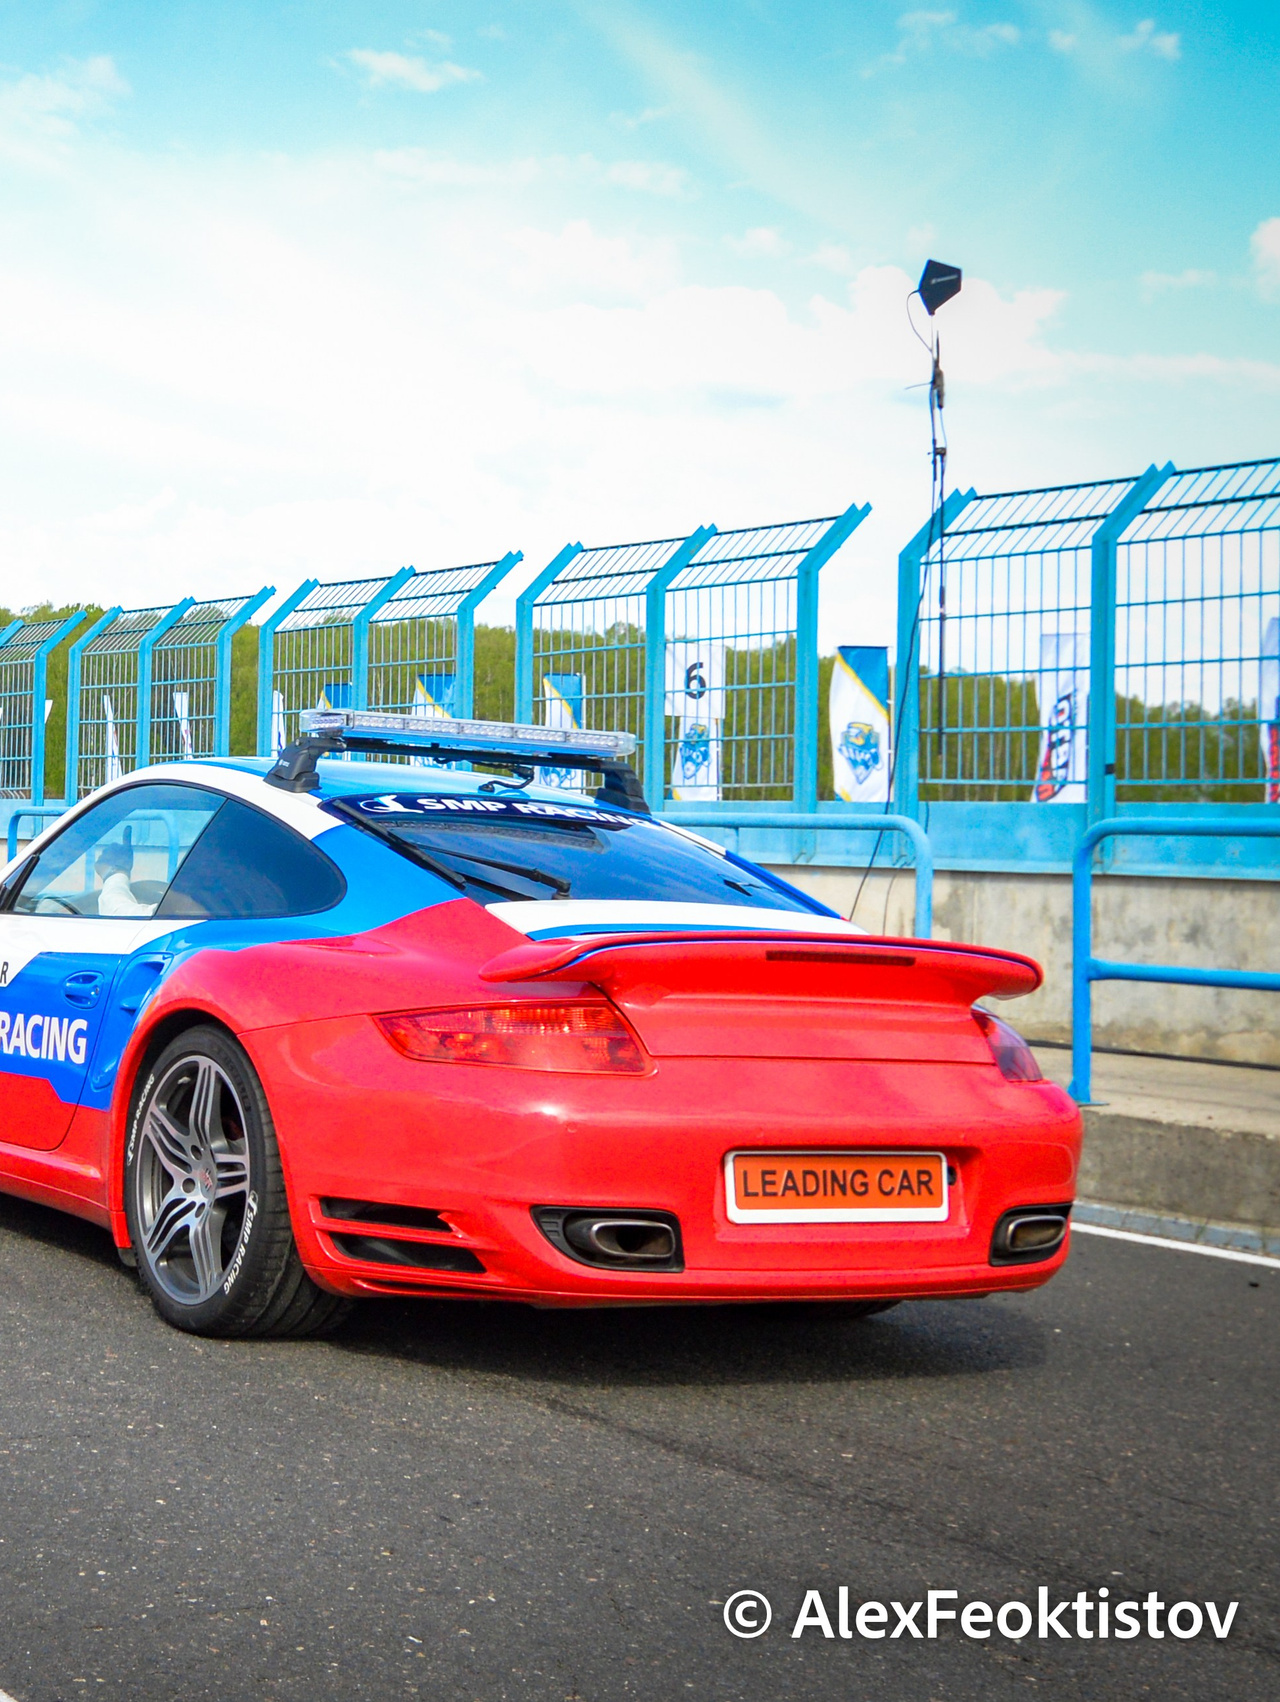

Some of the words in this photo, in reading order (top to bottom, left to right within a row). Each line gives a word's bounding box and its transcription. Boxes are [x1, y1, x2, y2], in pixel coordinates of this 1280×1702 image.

[684, 661, 706, 700] 6
[416, 798, 507, 812] SMP
[511, 802, 664, 830] RACING
[136, 1073, 155, 1120] RACING
[742, 1169, 870, 1197] LEADING
[877, 1168, 935, 1196] CAR
[244, 1210, 255, 1244] SMP
[223, 1243, 246, 1295] RACING
